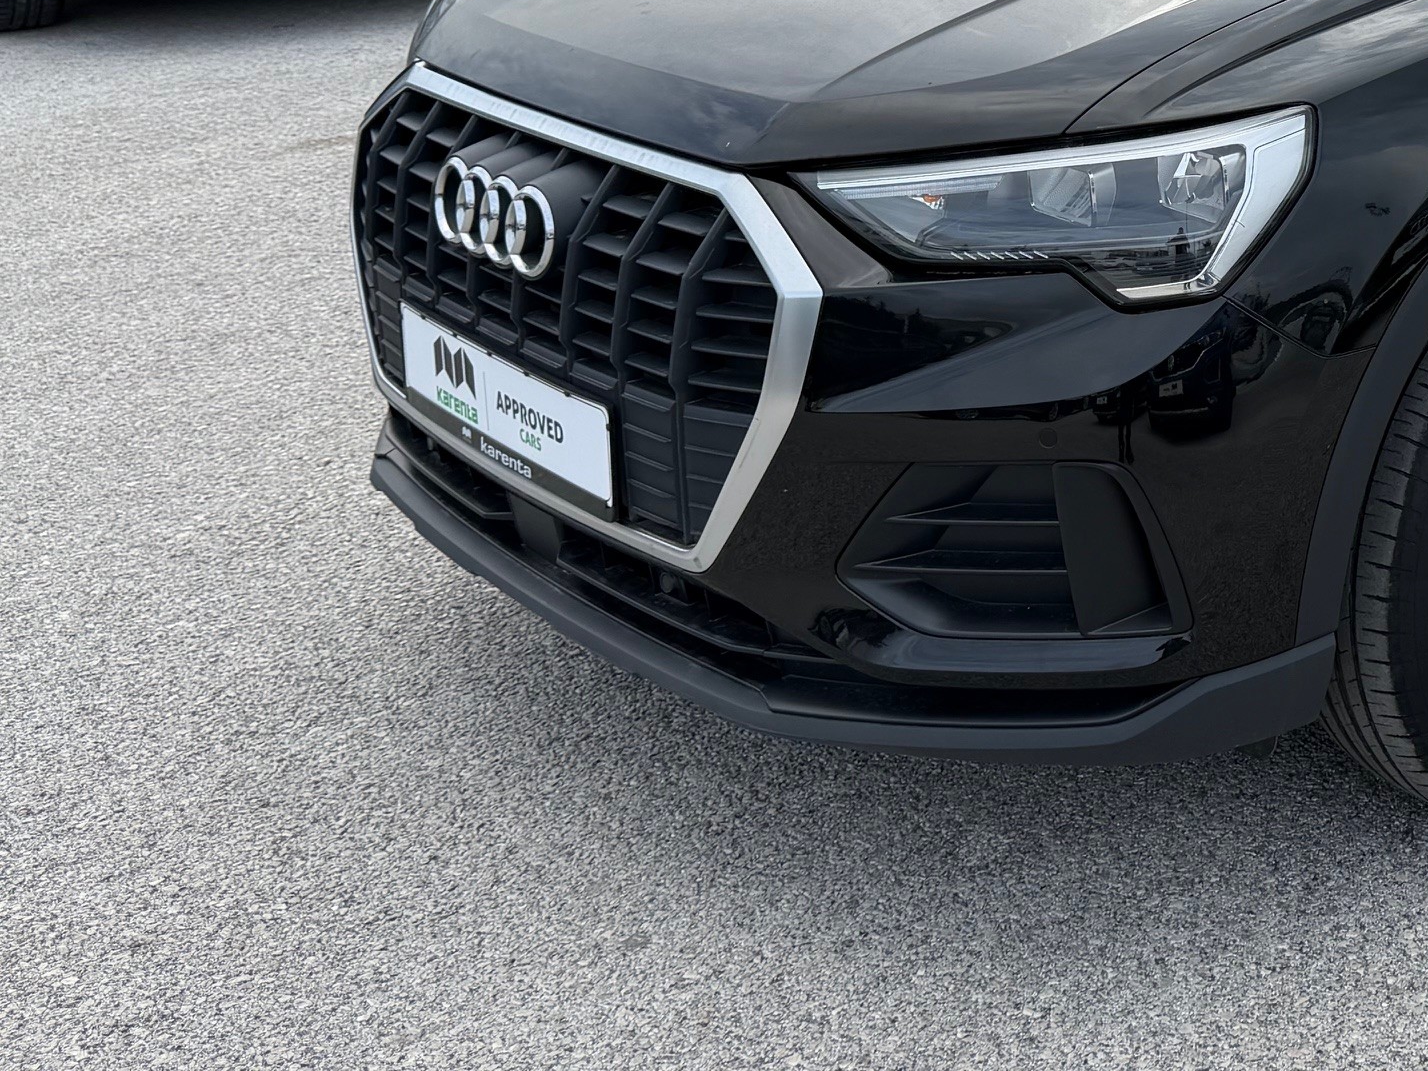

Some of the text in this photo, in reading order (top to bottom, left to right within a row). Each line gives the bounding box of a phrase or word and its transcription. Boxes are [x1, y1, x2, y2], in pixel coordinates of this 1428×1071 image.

[436, 386, 479, 425] karenta
[496, 390, 564, 444] APPROVED
[480, 436, 533, 479] karenta
[519, 428, 542, 451] CARS
